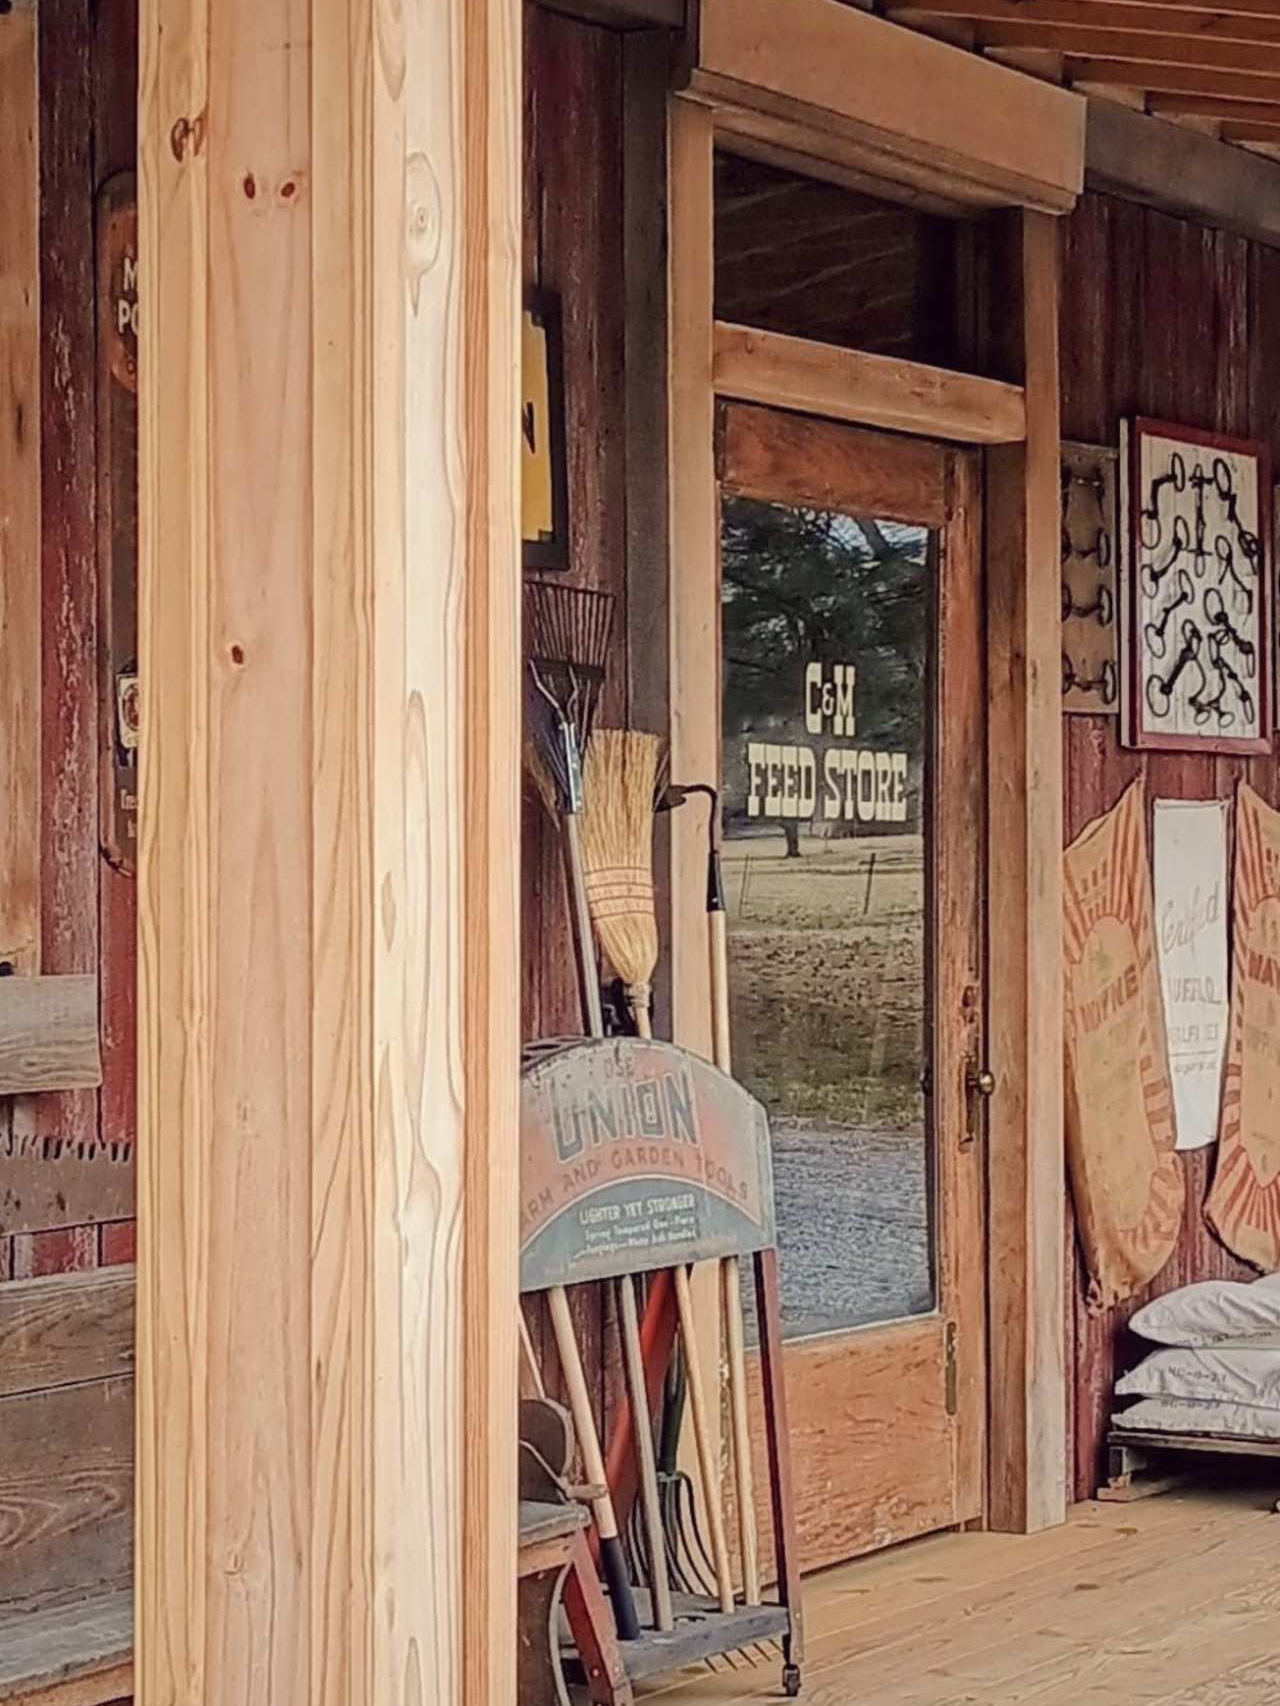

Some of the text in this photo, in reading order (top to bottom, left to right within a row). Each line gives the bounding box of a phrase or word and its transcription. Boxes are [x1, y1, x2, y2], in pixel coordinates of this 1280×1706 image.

[805, 661, 856, 737] C&M
[747, 743, 909, 823] FEED STORE
[606, 1057, 634, 1079] USE
[546, 1072, 700, 1165] UNION
[520, 1147, 749, 1226] ARM AND GARDEN TOOLS
[579, 1193, 696, 1226] LIGHTER YET STRONGER
